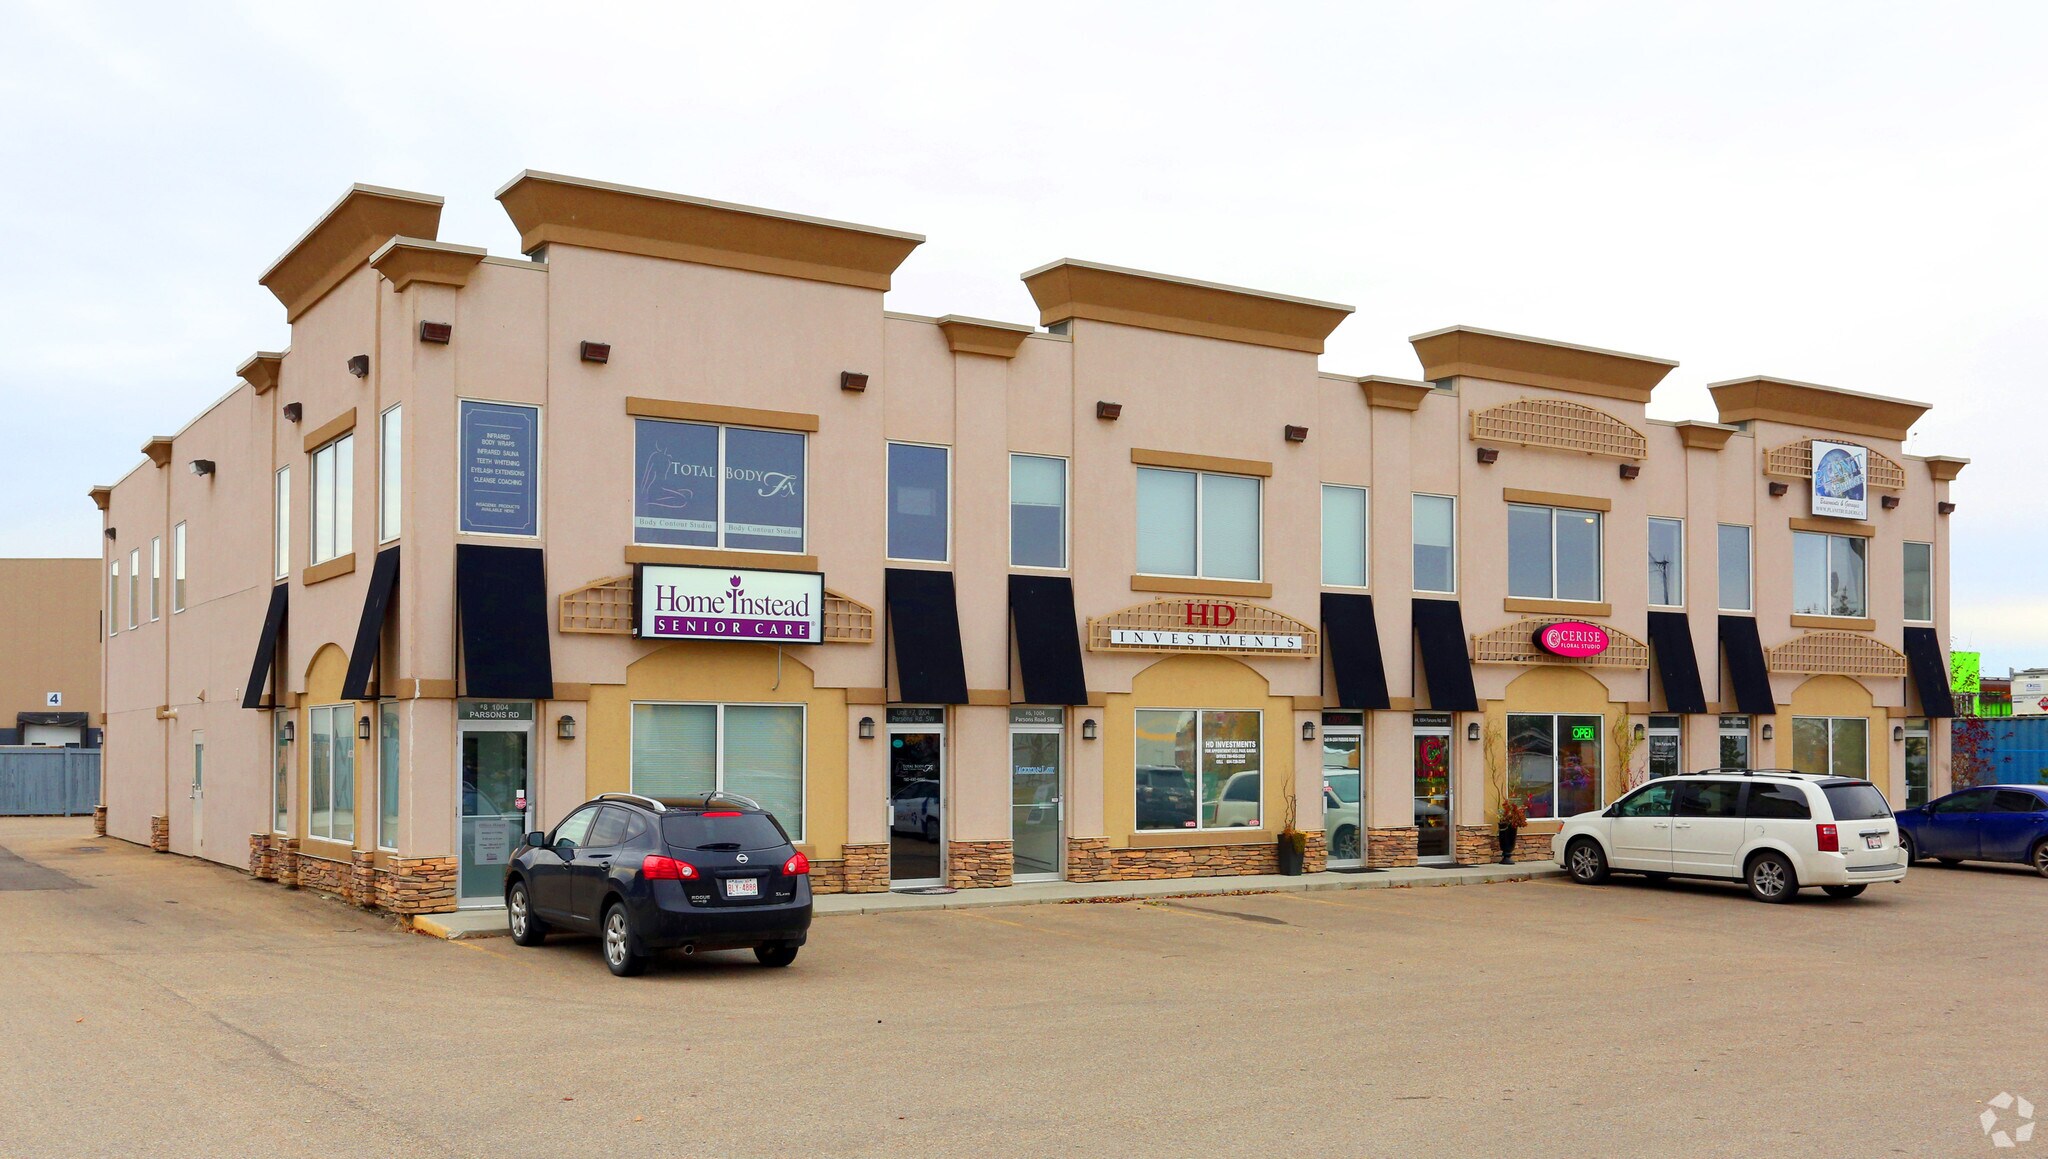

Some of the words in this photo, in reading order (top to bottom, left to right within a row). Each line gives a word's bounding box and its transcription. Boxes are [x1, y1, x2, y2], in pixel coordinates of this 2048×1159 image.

[477, 448, 500, 456] INFRARED
[494, 459, 520, 467] WHITENING
[470, 466, 493, 474] EYELASH
[495, 469, 525, 477] EXTENSIONS
[672, 461, 715, 478] TOTAL
[725, 466, 764, 482] BODY
[639, 518, 657, 527] Body
[659, 519, 687, 528] Contour
[690, 521, 712, 529] Studio
[728, 524, 746, 533] Body
[747, 525, 774, 534] Contour
[776, 527, 798, 535] Studio
[655, 584, 725, 614] Home
[730, 588, 810, 617] Instead
[1184, 602, 1236, 627] HD
[658, 619, 741, 633] SENIOR
[755, 623, 806, 636] CARE
[1119, 631, 1294, 648] INVESTMENTS
[1561, 630, 1601, 643] CERISE
[49, 693, 59, 704] 4
[480, 703, 488, 711] #8
[1572, 727, 1595, 739] OPEN
